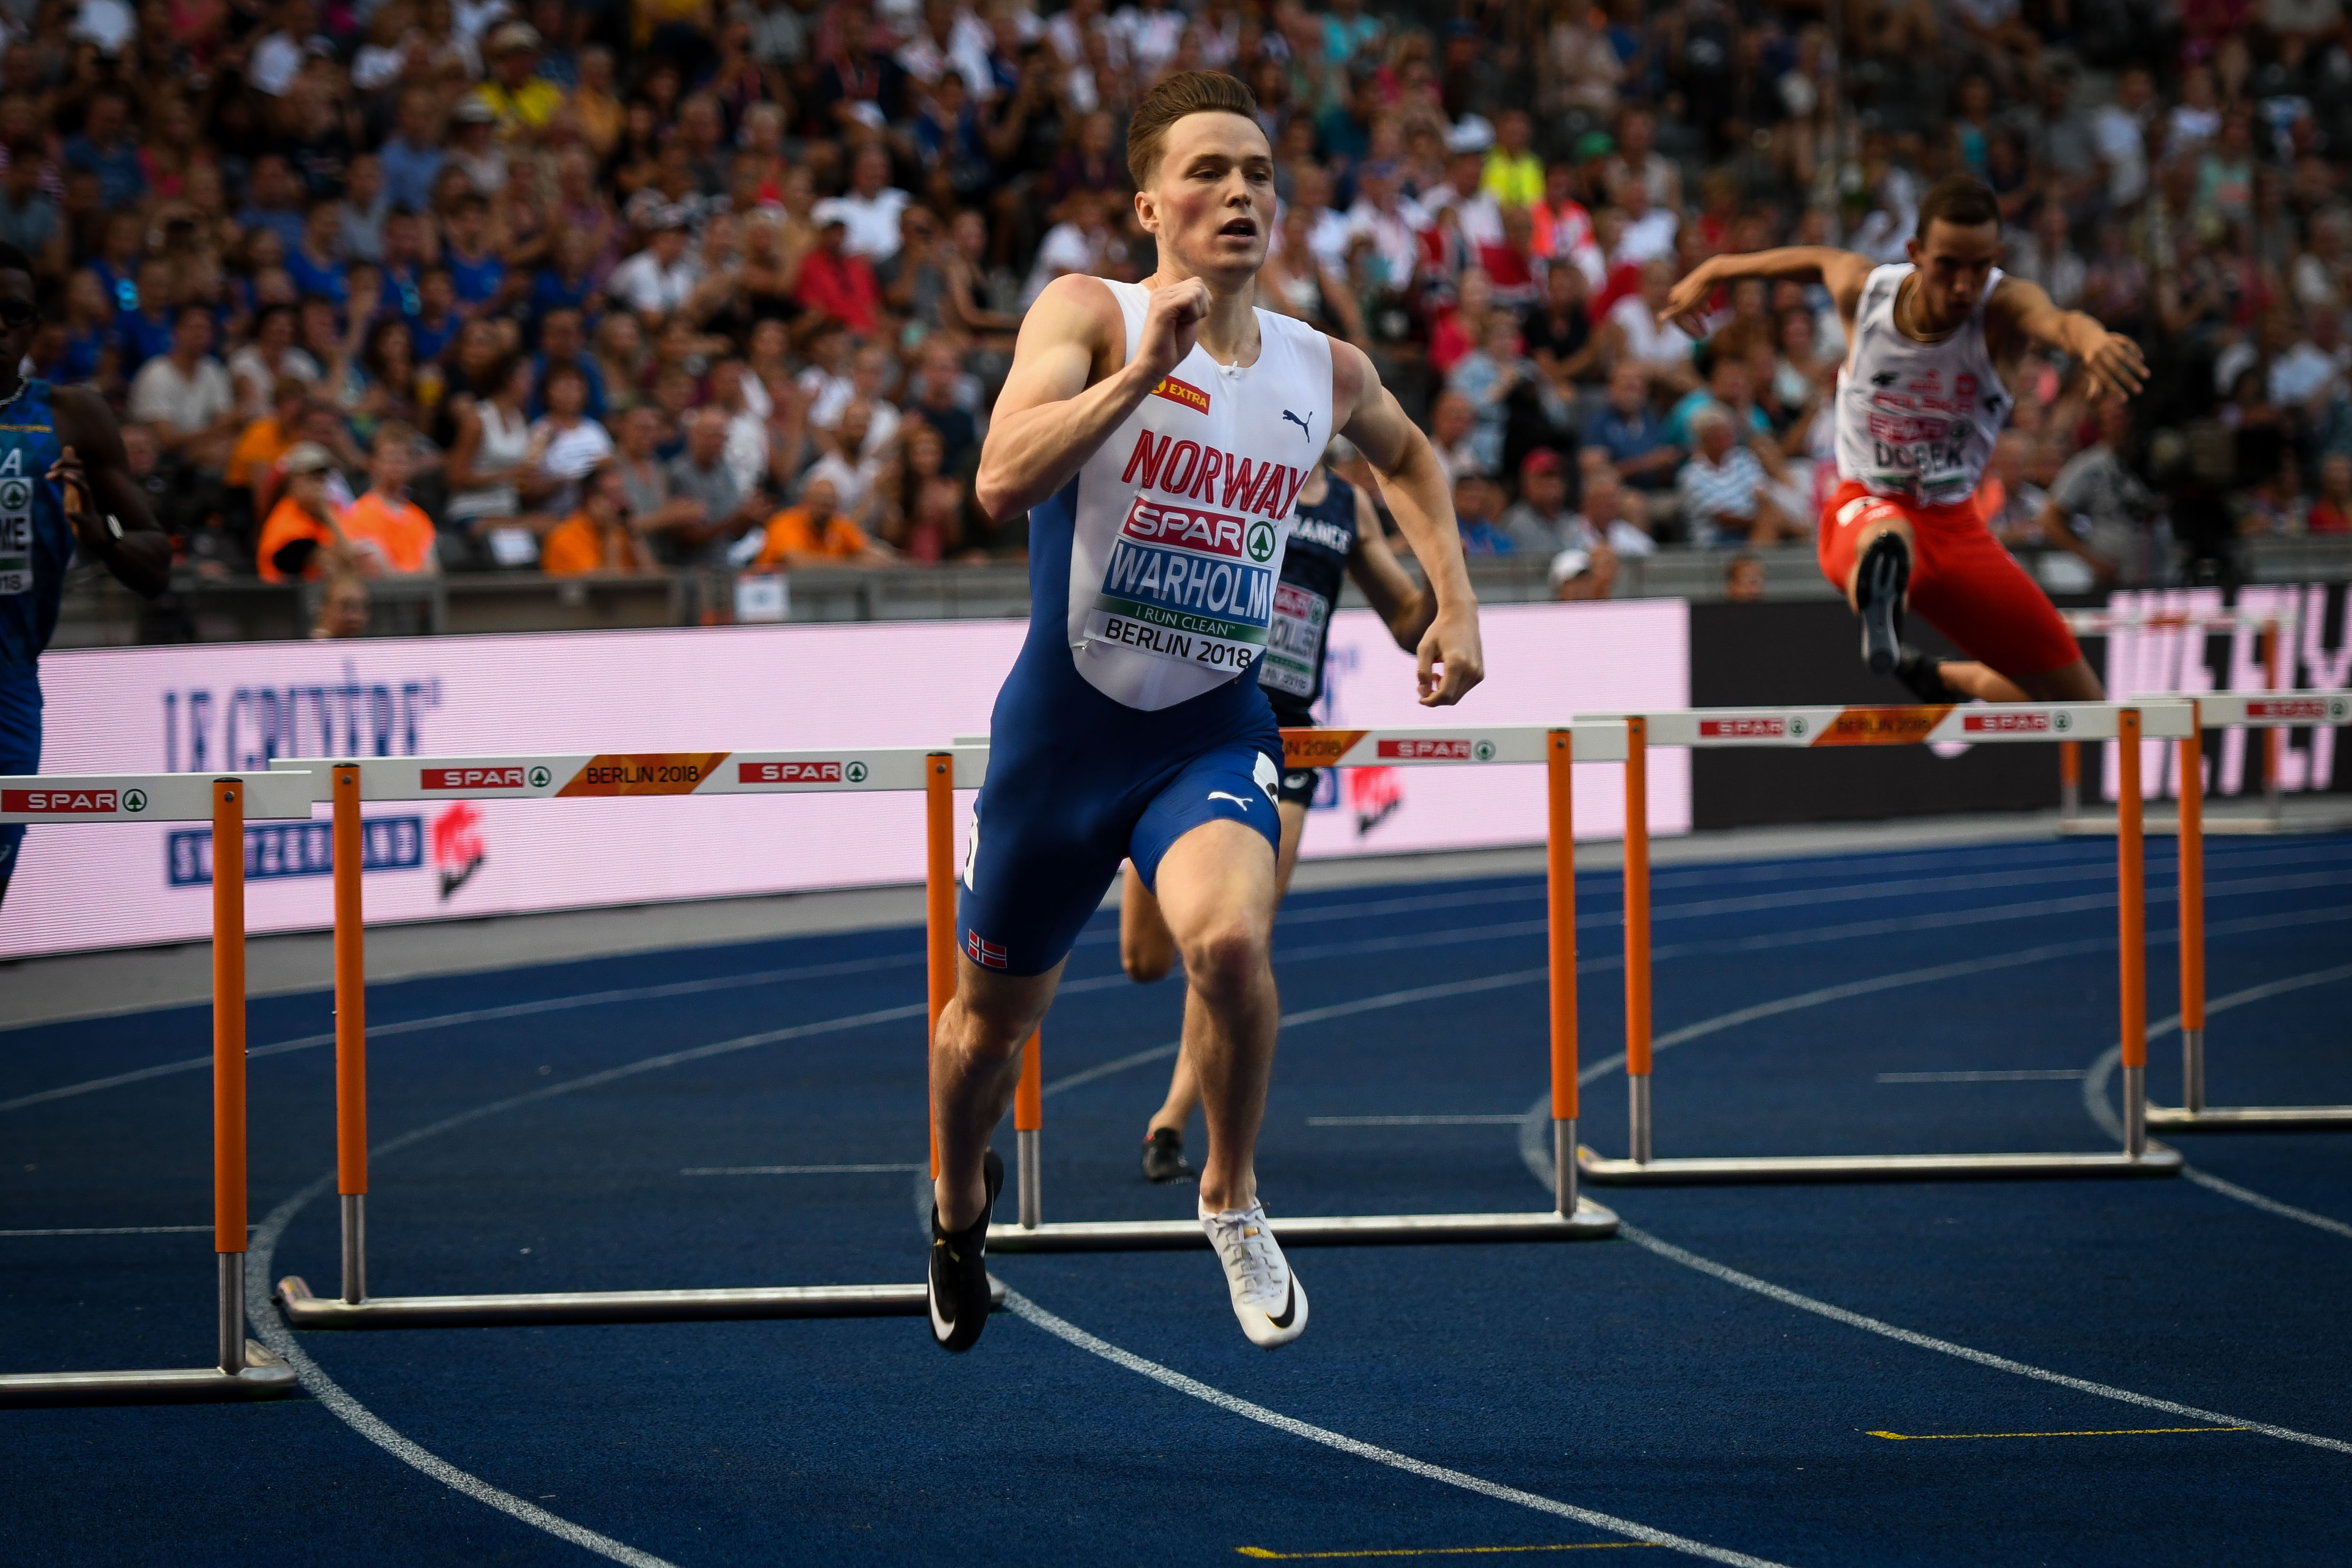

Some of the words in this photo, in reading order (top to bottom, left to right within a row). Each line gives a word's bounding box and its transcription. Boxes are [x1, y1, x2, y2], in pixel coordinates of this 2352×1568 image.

[1169, 384, 1207, 408] EXTRA
[1121, 429, 1308, 520] NORWAY
[1132, 506, 1241, 551] SPAR
[1288, 514, 1352, 555] RANCE
[1110, 543, 1269, 620] WARHOLM
[1146, 608, 1177, 626] RUN
[1104, 618, 1191, 658] BERLIN
[1199, 640, 1252, 668] 2018
[1398, 741, 1470, 757] SPAR
[444, 770, 523, 786] SPAR
[587, 767, 653, 784] BERLIN
[658, 765, 699, 783] 2018
[761, 763, 840, 779] SPAR
[28, 794, 115, 808] SPAR
